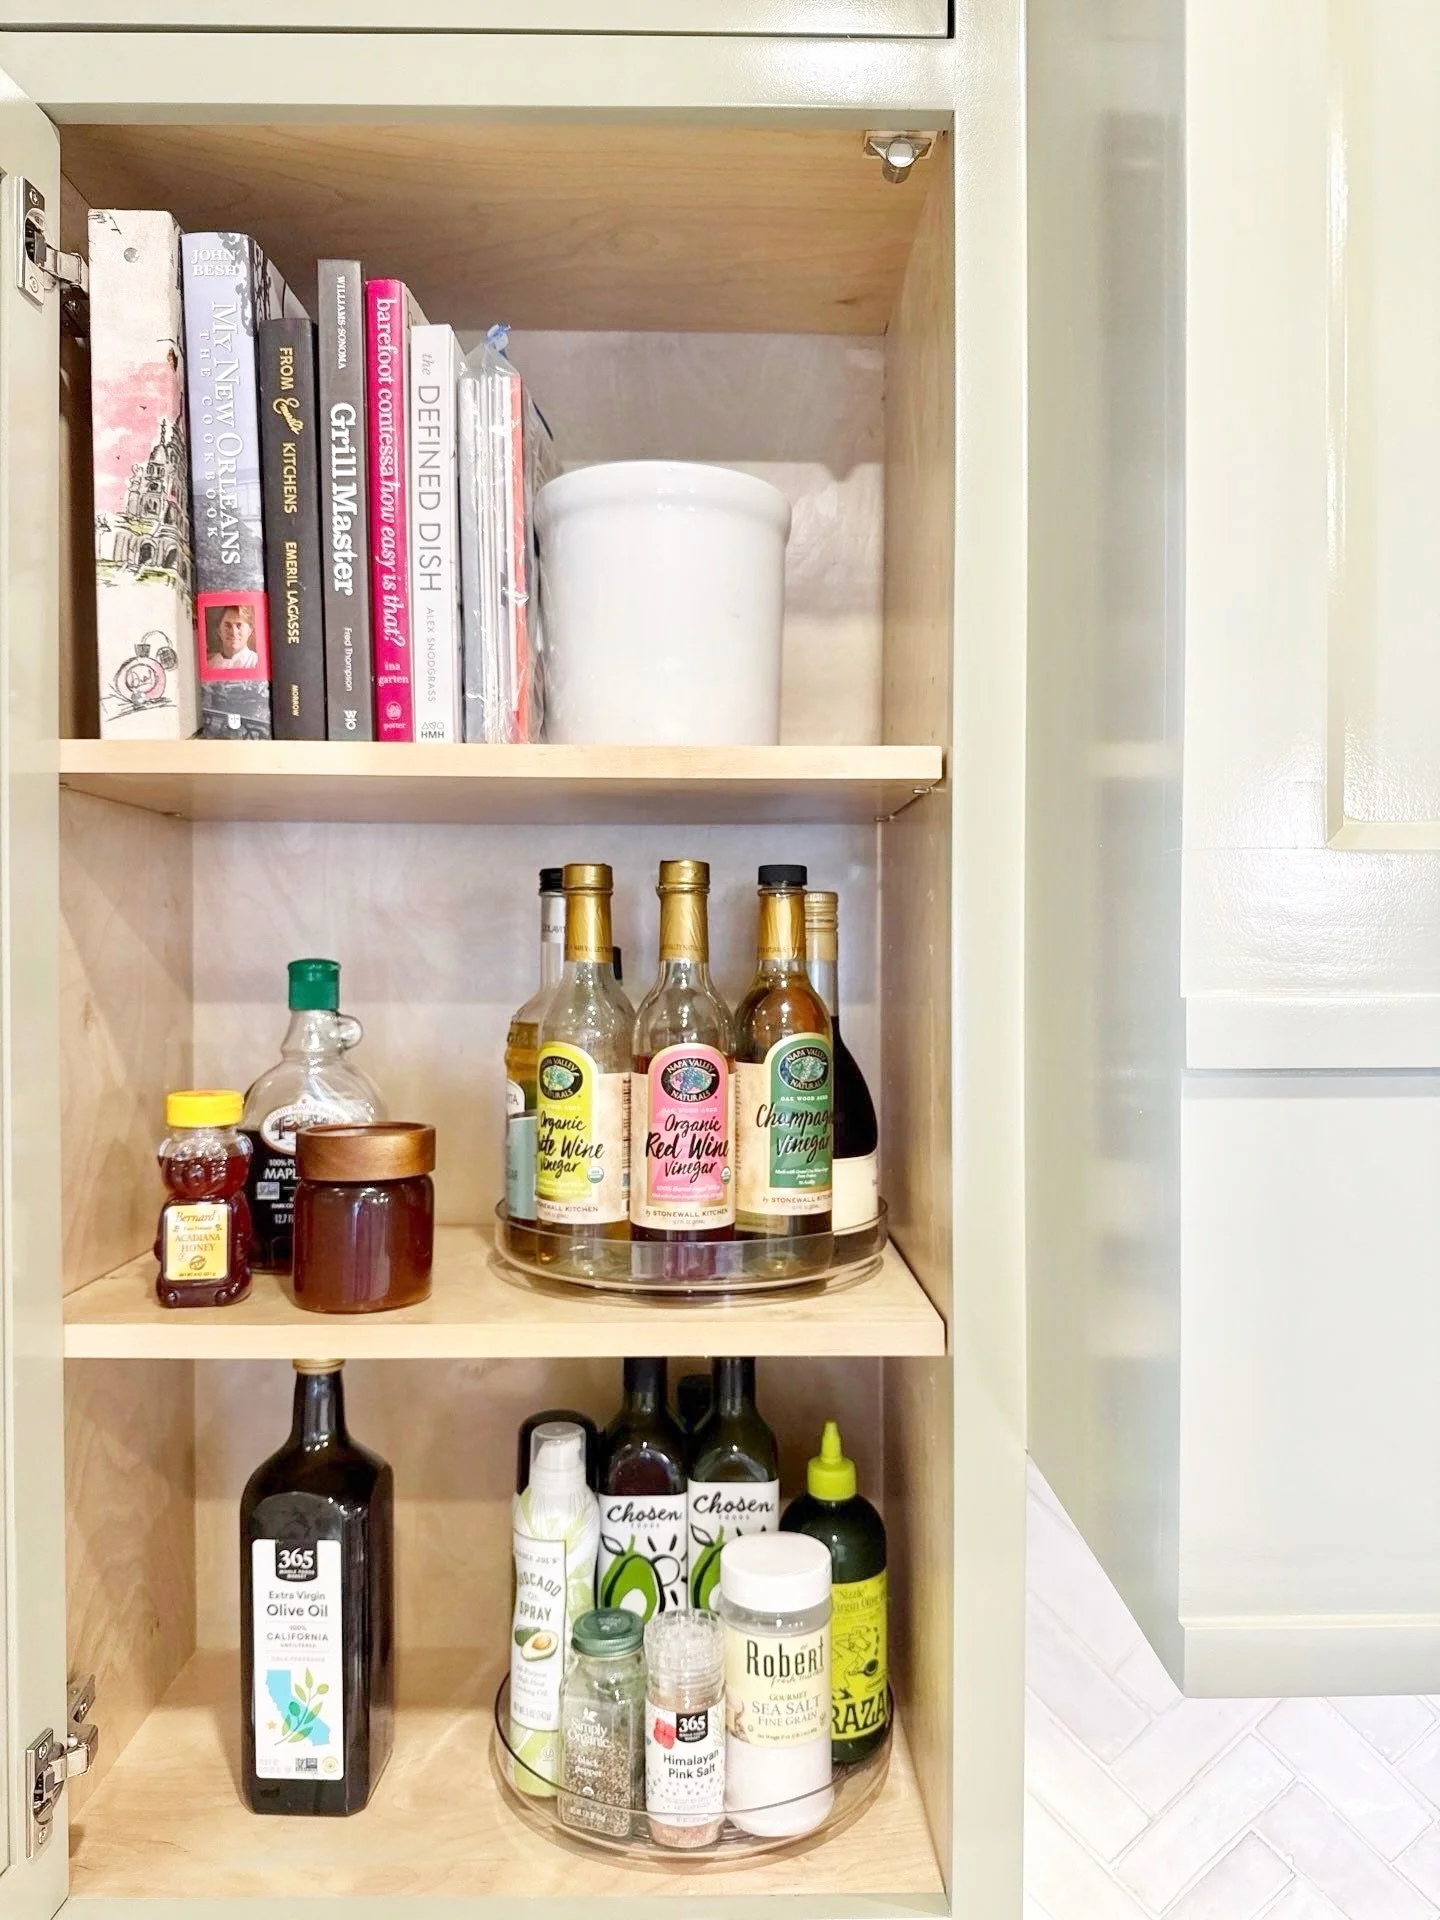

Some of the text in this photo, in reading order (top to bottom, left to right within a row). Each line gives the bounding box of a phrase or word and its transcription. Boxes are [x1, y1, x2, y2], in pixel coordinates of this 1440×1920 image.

[190, 250, 237, 264] JOHN
[191, 264, 238, 277] BESH
[336, 275, 347, 370] WILLIAMS-SONOMA
[280, 347, 294, 390] FROM
[200, 330, 217, 537] THE COOKBOOK
[283, 442, 298, 514] KITCHENS
[375, 298, 407, 647] barefoot contessa how easy is that?
[418, 353, 442, 591] the DEFINED DISH
[331, 402, 358, 596] Grill Master
[286, 542, 300, 644] EMERIL LAGASSE
[344, 627, 353, 692] Fred Thompson
[426, 607, 438, 702] ALEX SNODGRASS
[384, 661, 401, 671] ina
[377, 675, 409, 688] garten
[667, 1059, 716, 1073] NAPA VALLEY
[786, 1050, 806, 1063] NAPA
[671, 1090, 711, 1102] NATURALS
[664, 1113, 722, 1138] Organic
[561, 1134, 606, 1159] Wine
[645, 1131, 682, 1160] Red
[264, 1168, 301, 1180] MAPL
[664, 1160, 719, 1184] Vinegar
[771, 1196, 816, 1204] STONEWALL
[652, 1209, 700, 1218] STONEWALL
[702, 1208, 729, 1217] KITCHEN
[175, 1233, 221, 1242] ACADIANA
[180, 1243, 216, 1252] HONEY
[606, 1501, 681, 1523] Chosen
[692, 1490, 771, 1514] Chosen
[278, 1547, 314, 1570] 365
[268, 1590, 326, 1602] Extra Virgin
[266, 1604, 328, 1617] Olive Oil
[519, 1600, 552, 1622] SPRAY
[266, 1632, 329, 1641] CALIFORNIA
[752, 1694, 820, 1716] SEA SALT
[769, 1691, 807, 1701] GOURMET
[758, 1711, 818, 1727] FINE GRAIN
[832, 1690, 886, 1734] RAZA
[571, 1717, 608, 1740] Simply
[679, 1715, 706, 1733] 365
[567, 1728, 612, 1748] Organic
[663, 1749, 719, 1766] Himalayan
[668, 1763, 716, 1779] Pink Salt
